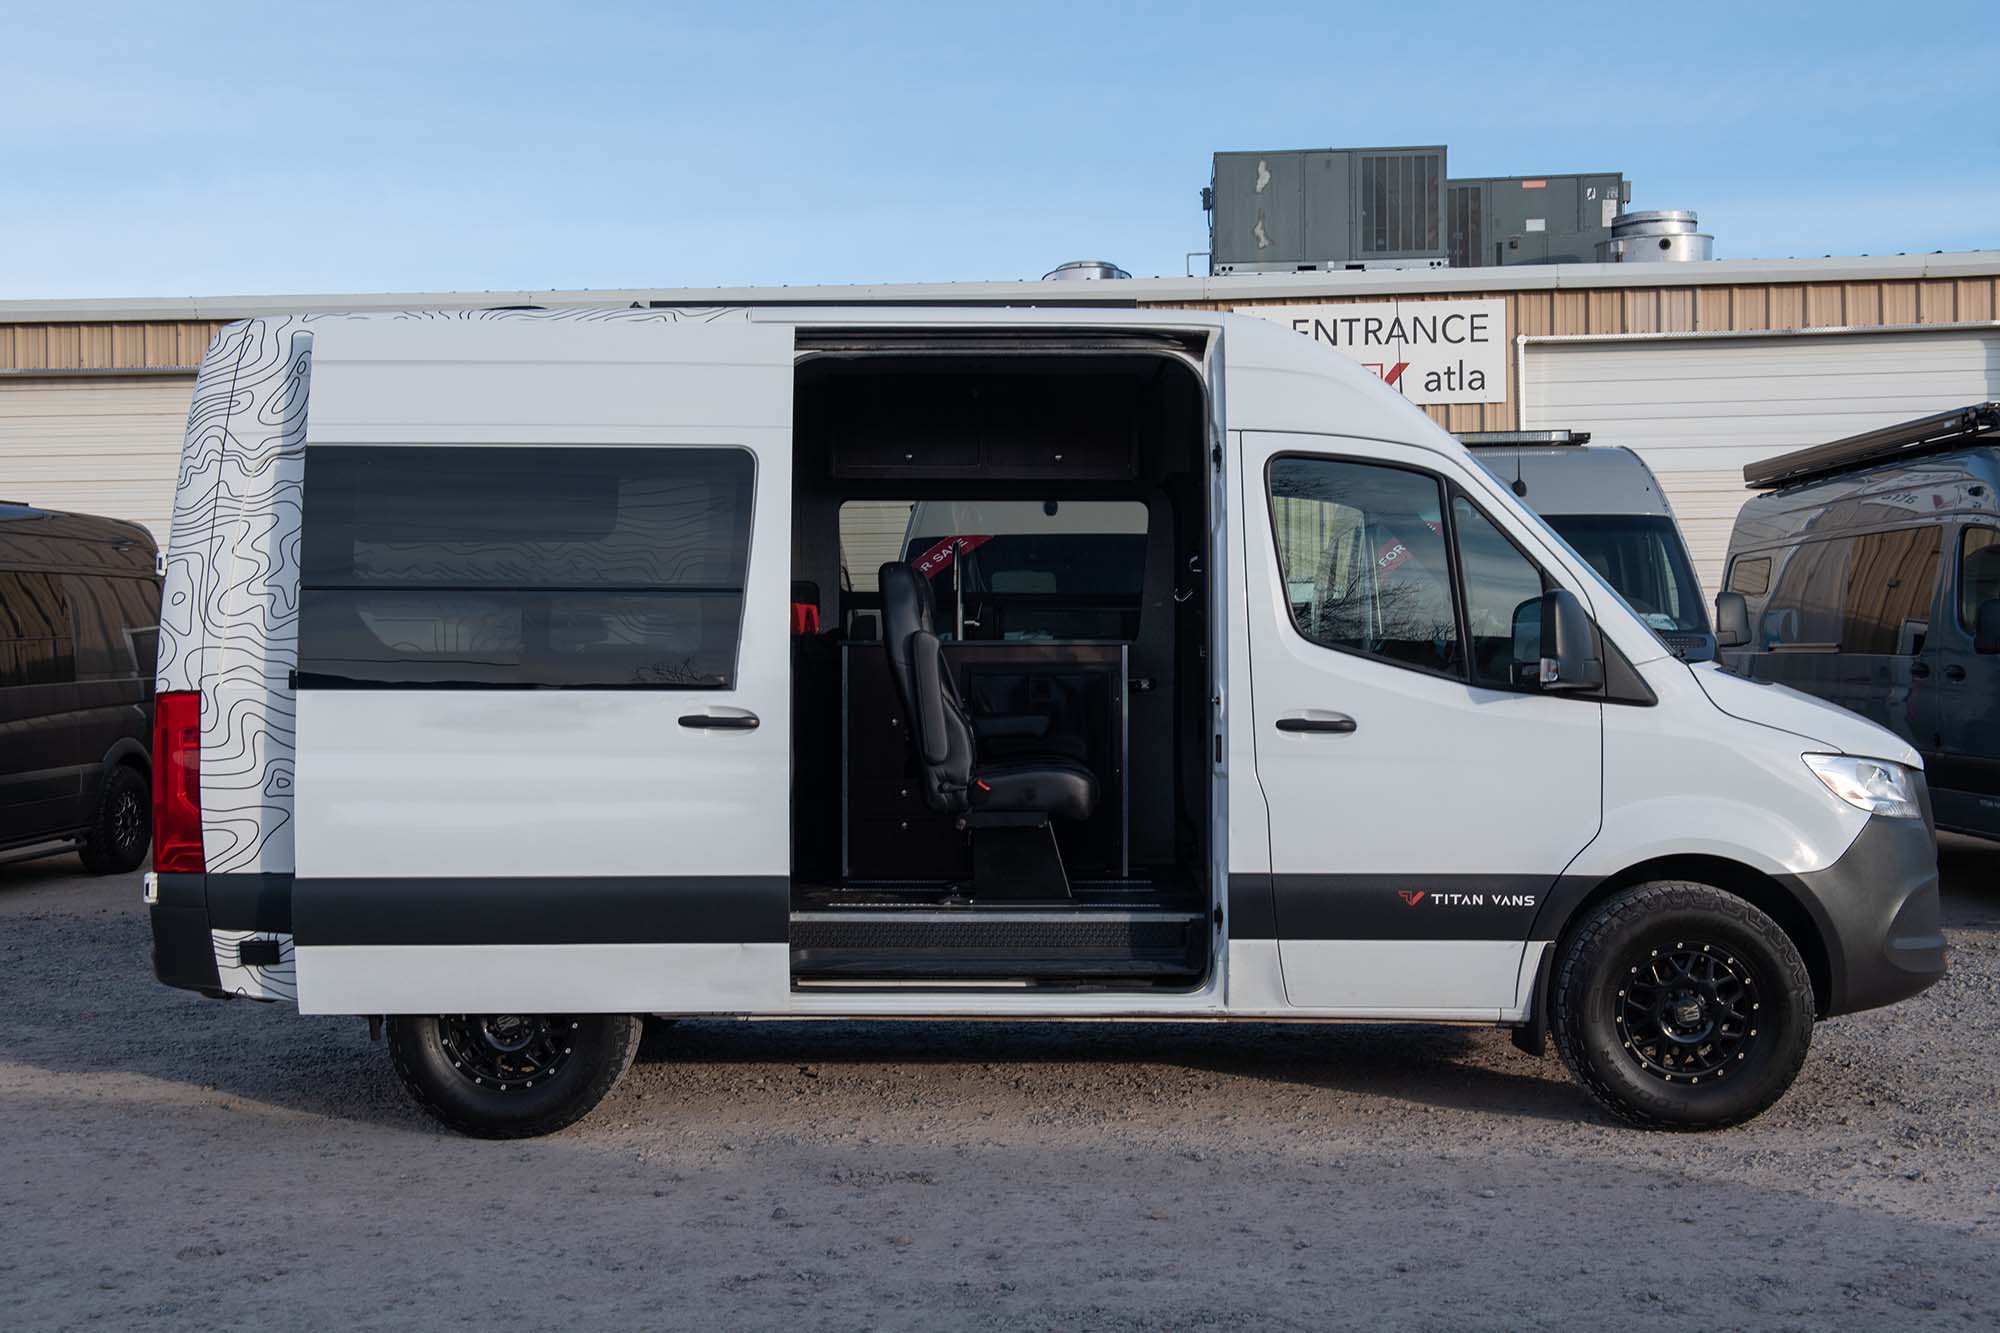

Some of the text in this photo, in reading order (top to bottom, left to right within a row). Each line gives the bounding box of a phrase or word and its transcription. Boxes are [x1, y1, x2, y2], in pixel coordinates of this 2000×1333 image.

[1424, 359, 1486, 393] atla
[932, 538, 968, 562] SAE
[1378, 544, 1407, 568] FOR
[1430, 893, 1536, 907] TITAN VANS
